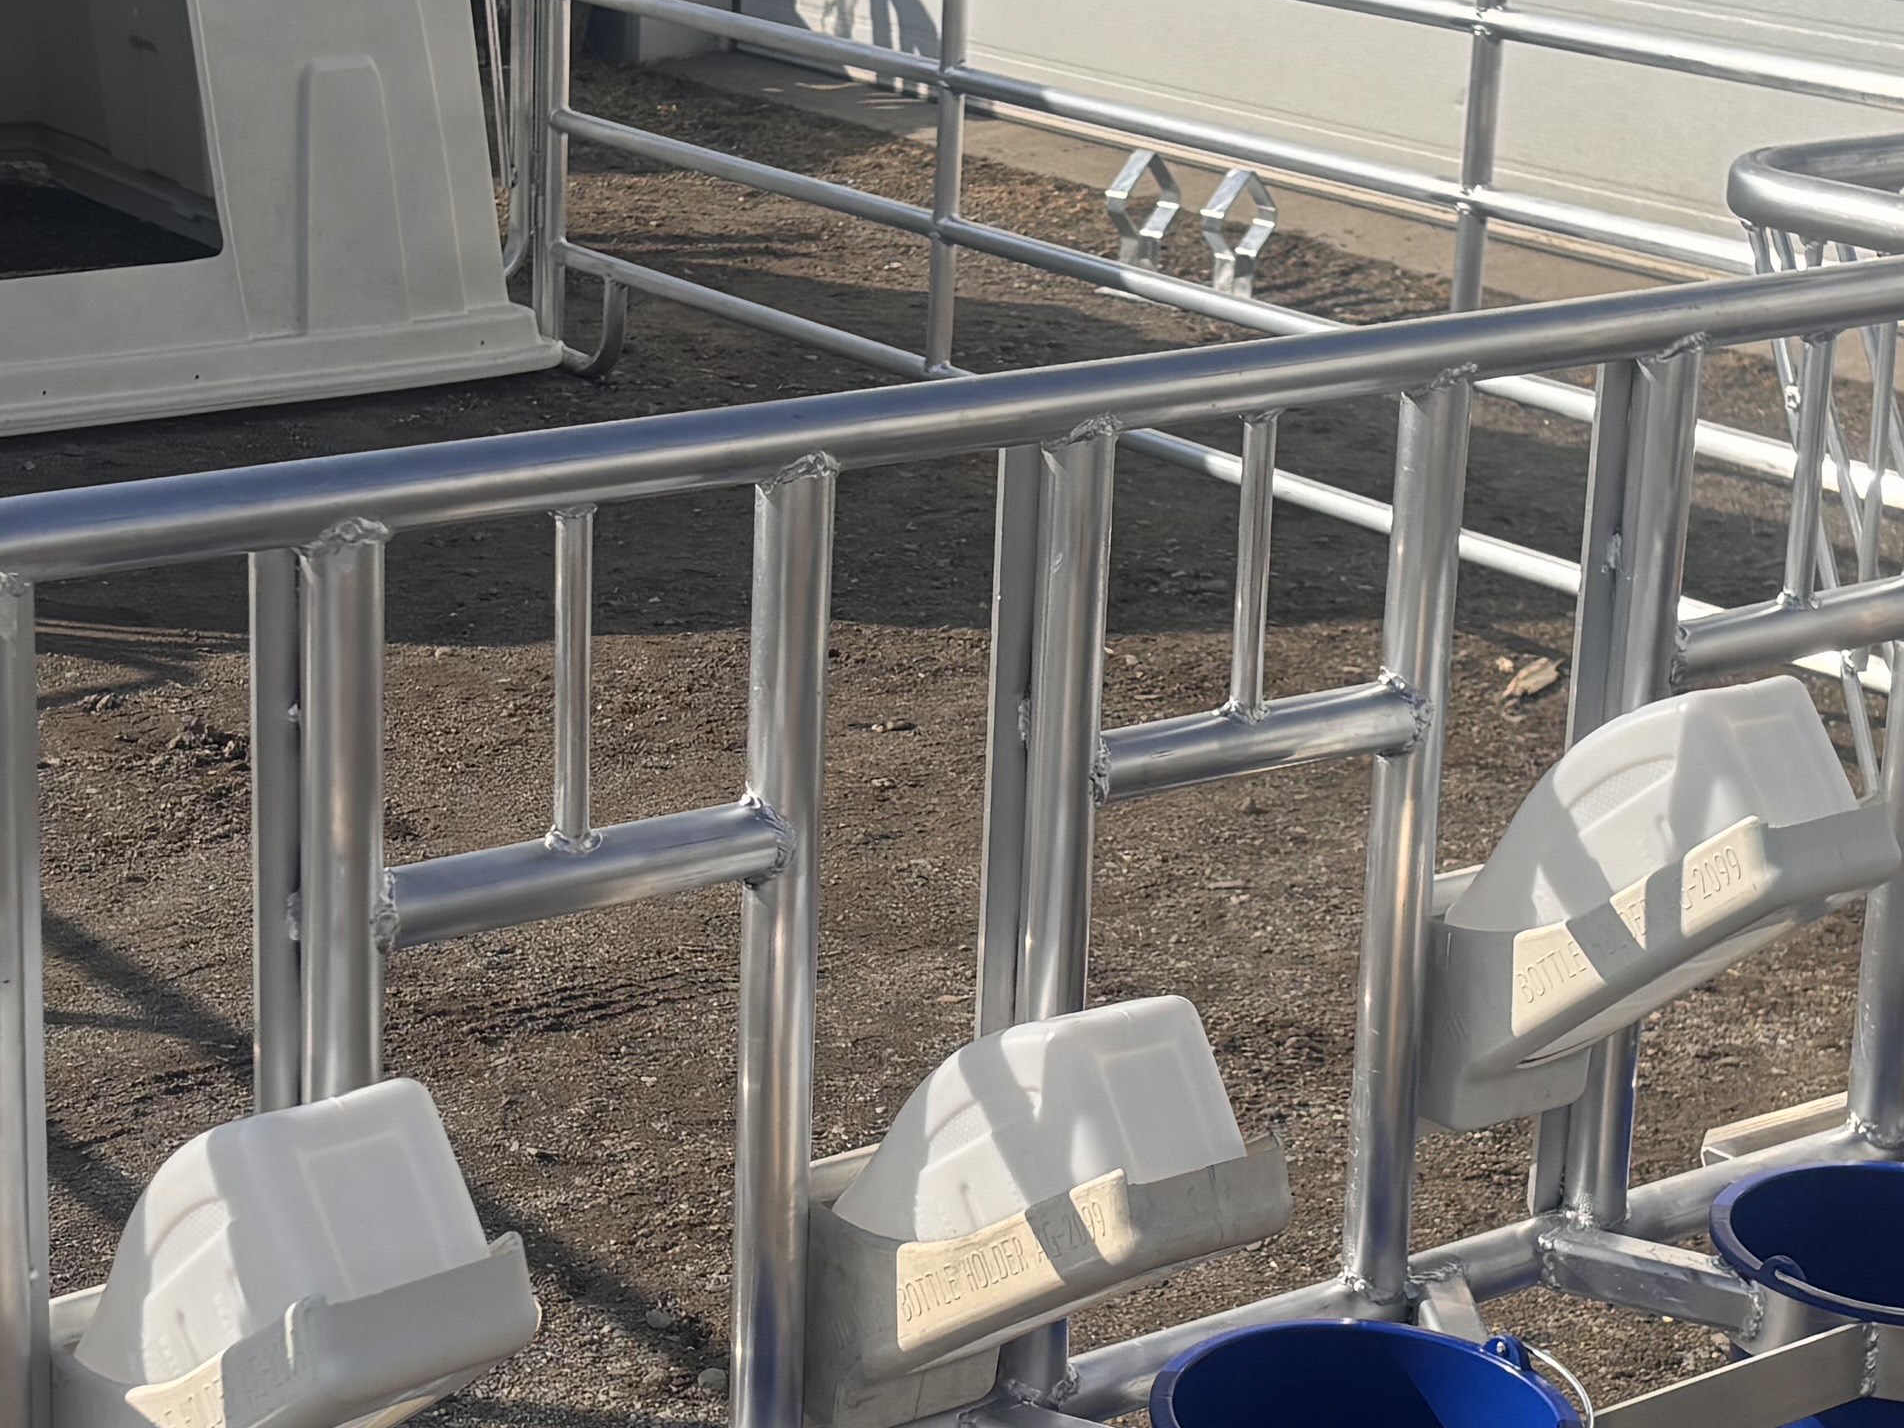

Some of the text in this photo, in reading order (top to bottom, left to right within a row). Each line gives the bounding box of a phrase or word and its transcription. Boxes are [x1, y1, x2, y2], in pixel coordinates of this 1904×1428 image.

[1515, 940, 1587, 1004] BOTTLE
[897, 1263, 961, 1322] BOTTLE
[963, 1236, 1029, 1292] HOLDER
